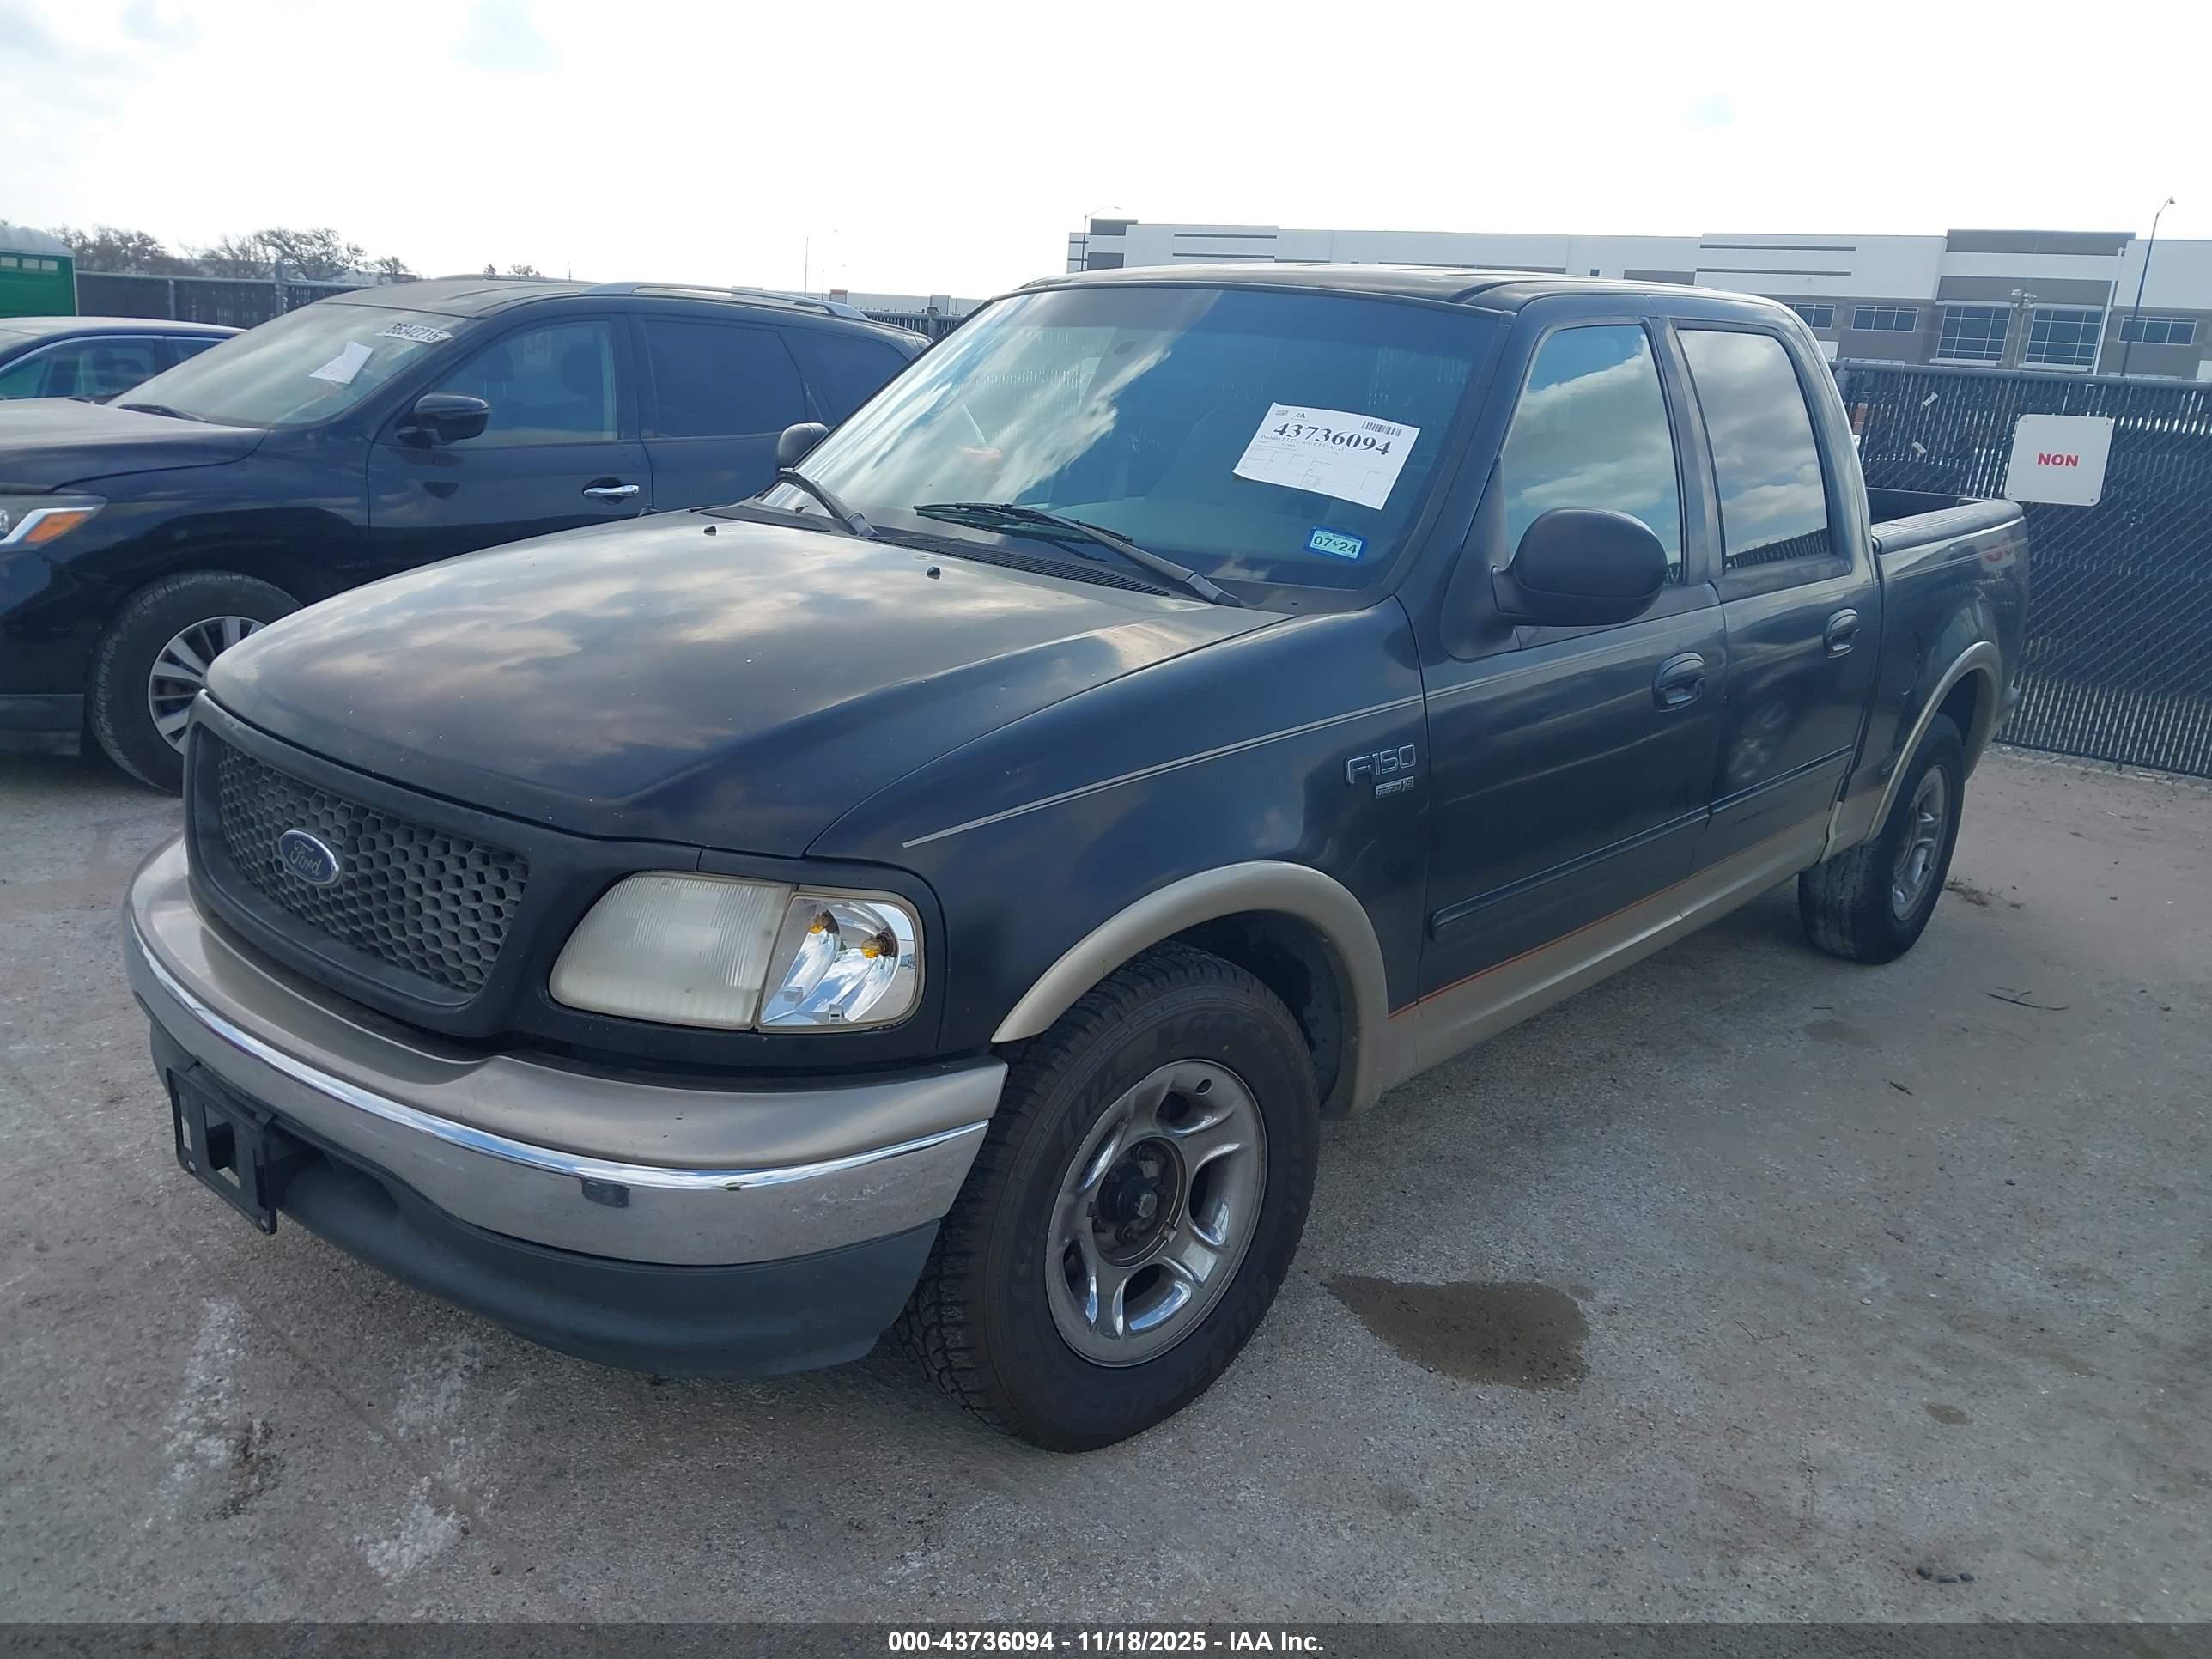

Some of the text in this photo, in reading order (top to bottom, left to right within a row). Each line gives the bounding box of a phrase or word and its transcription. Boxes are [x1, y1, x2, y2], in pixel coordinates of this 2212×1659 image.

[1273, 422, 1392, 456] 43736094
[2038, 453, 2079, 467] NON
[290, 840, 323, 876] Ford
